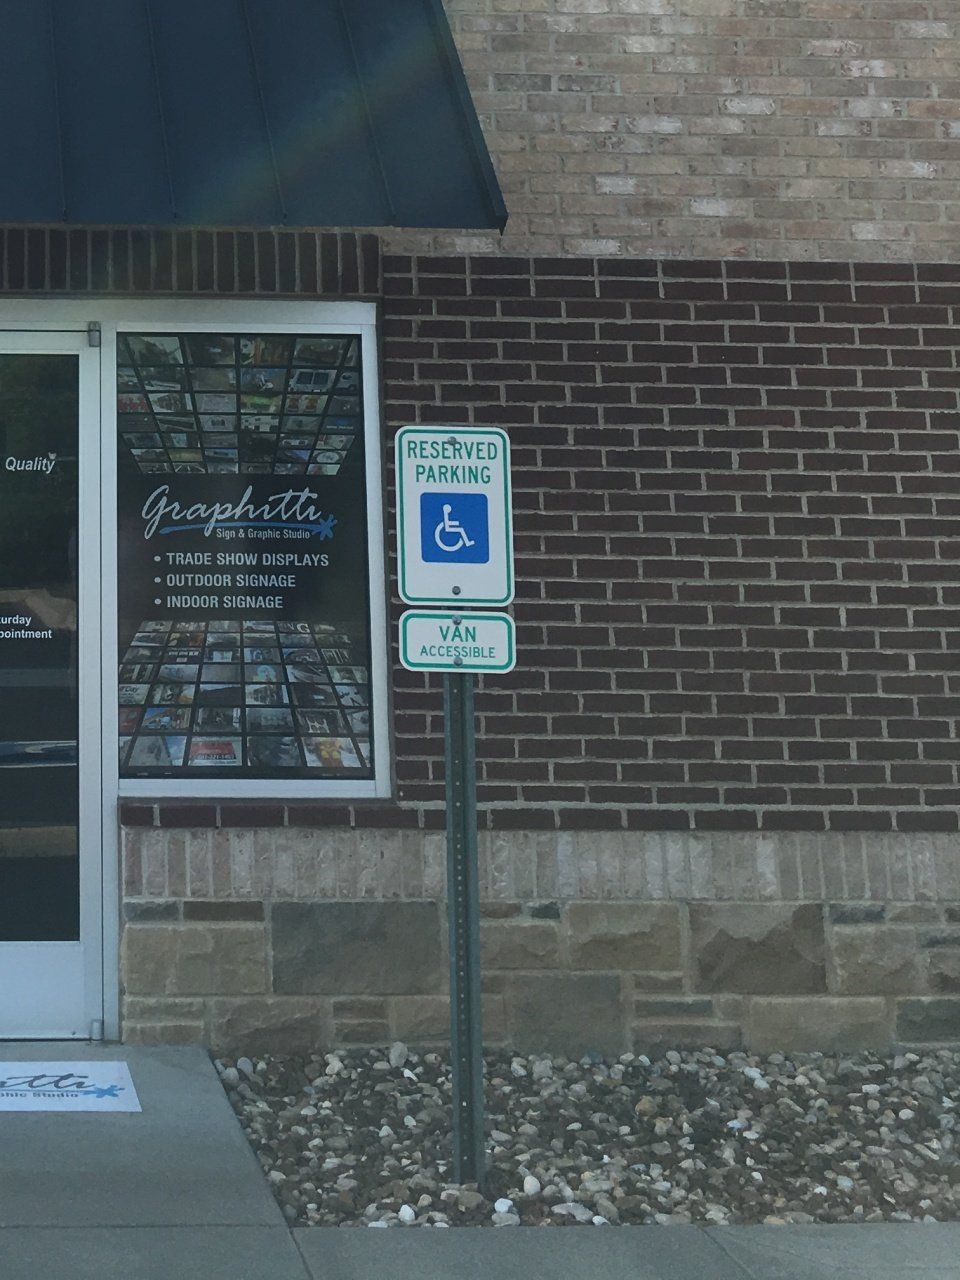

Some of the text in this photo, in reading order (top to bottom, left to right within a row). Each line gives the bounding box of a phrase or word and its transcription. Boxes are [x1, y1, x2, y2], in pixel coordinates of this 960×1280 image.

[407, 440, 498, 460] RESERVED
[5, 456, 56, 474] Quality
[415, 464, 491, 484] PARKING
[141, 485, 322, 540] Graphitti
[216, 528, 310, 540] Sign & Graphic Studio
[166, 552, 329, 567] TRADE SHOW DISPLAYS
[166, 574, 296, 588] OUTDOOR SIGNAGE
[167, 595, 283, 609] INDOOR SIGNAGE
[439, 625, 477, 642] VAN
[420, 645, 496, 659] ACCESSIBLE
